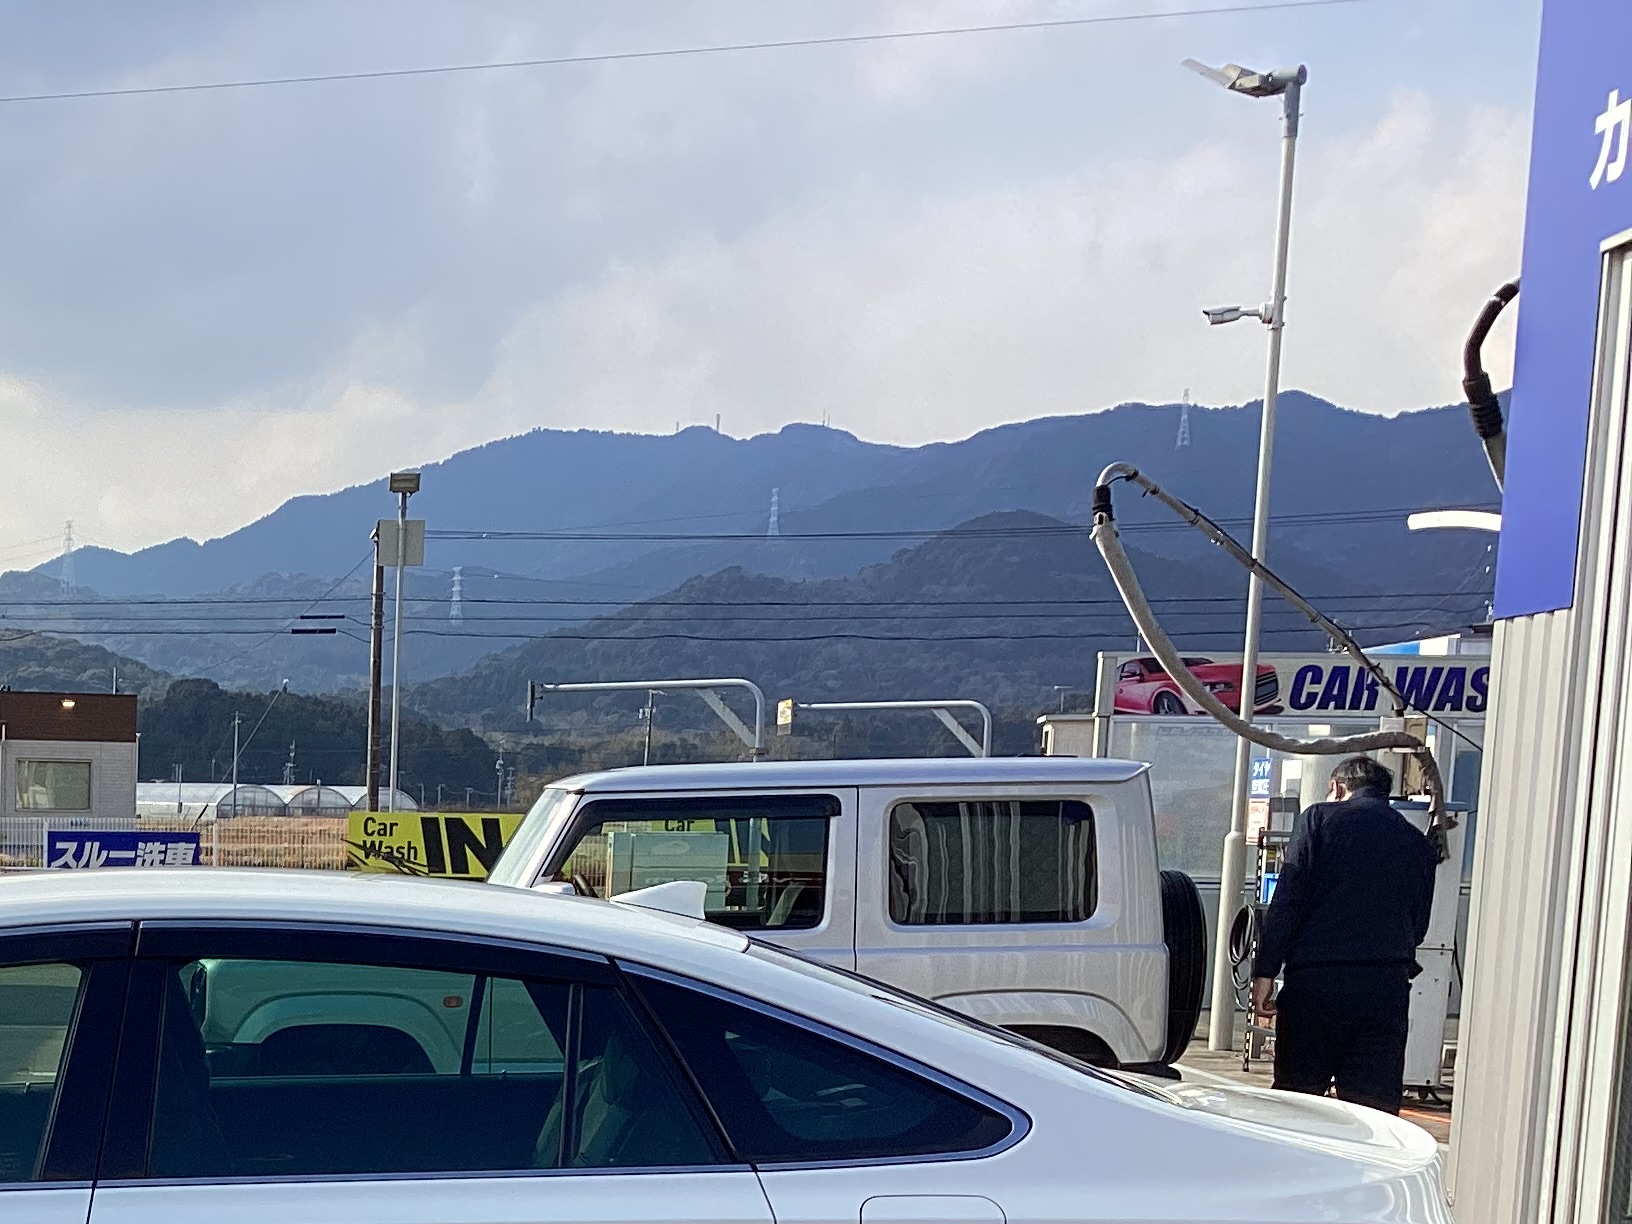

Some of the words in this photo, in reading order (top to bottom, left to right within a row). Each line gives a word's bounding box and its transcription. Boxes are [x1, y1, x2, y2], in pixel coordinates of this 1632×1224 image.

[363, 816, 399, 837] Car
[51, 841, 196, 868] スルー洗車
[362, 840, 418, 861] Wash
[420, 817, 505, 874] IN
